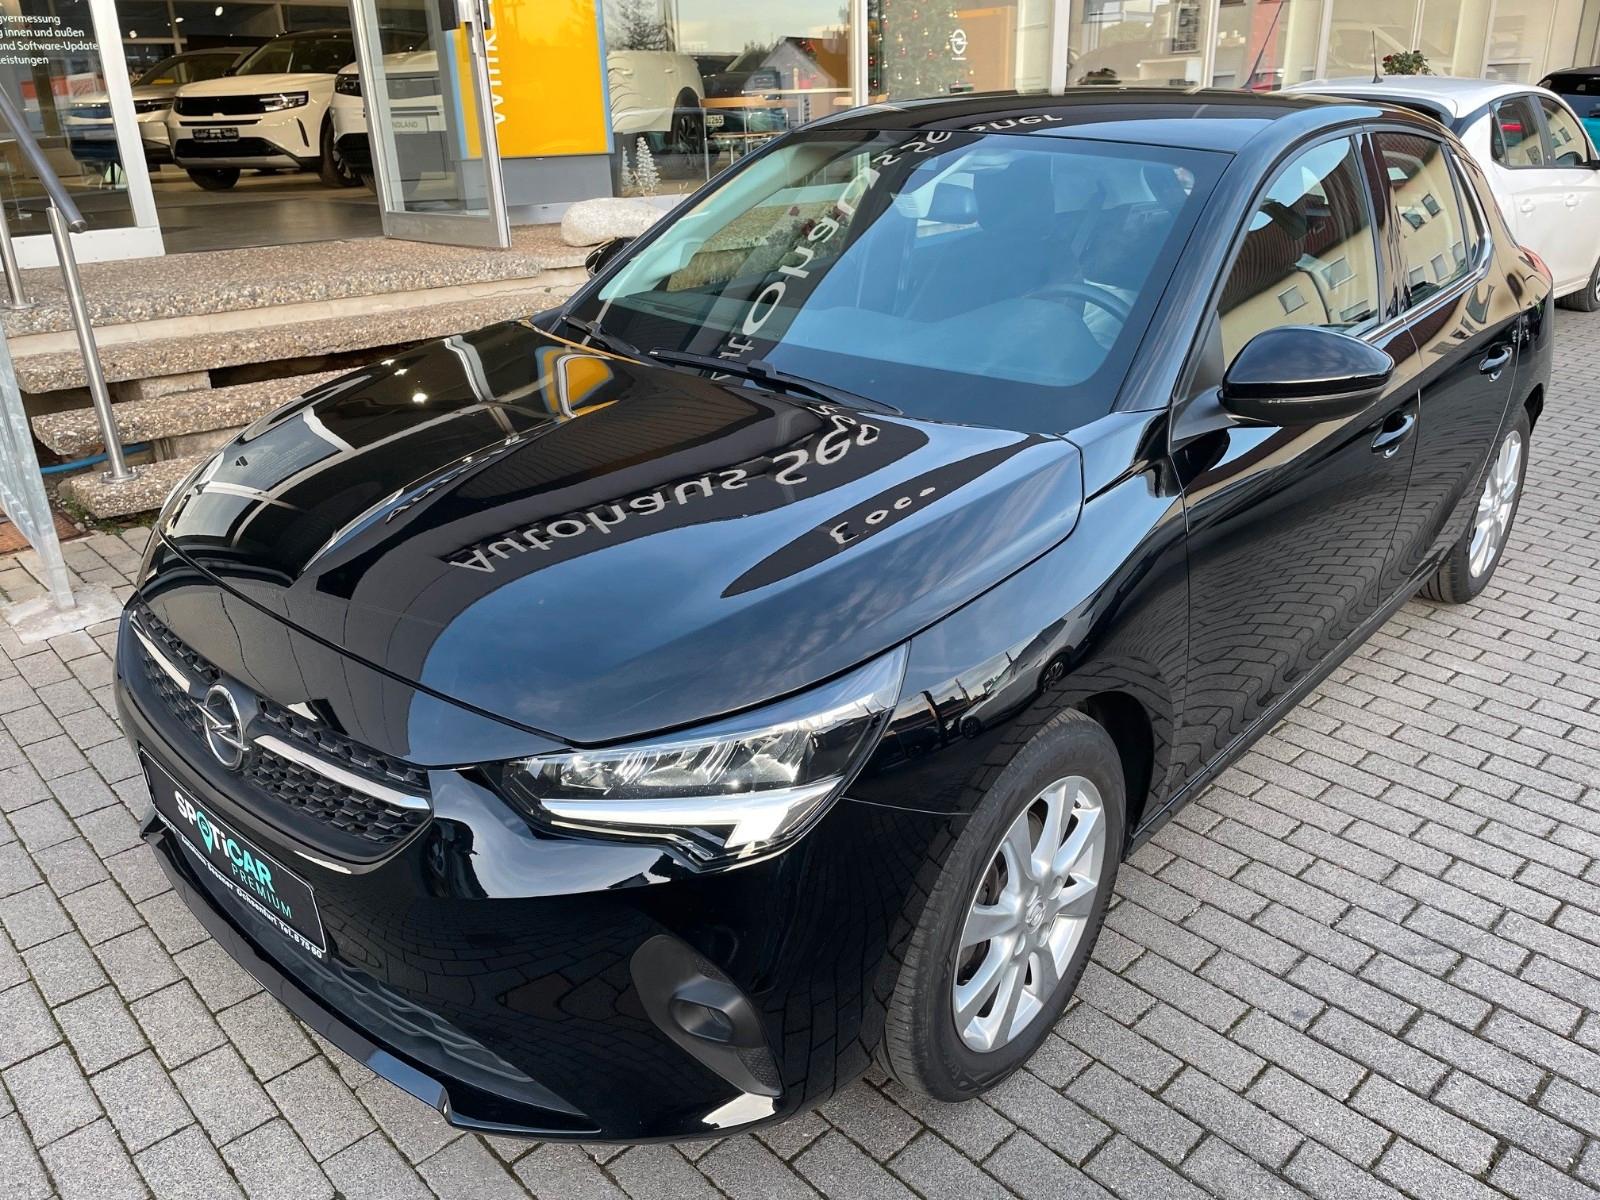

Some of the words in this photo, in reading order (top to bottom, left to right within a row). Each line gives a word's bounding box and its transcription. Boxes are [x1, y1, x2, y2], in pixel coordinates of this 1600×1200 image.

[5, 28, 32, 37] innen
[34, 27, 53, 37] und
[54, 27, 84, 37] außen
[231, 862, 293, 919] PREMIUM
